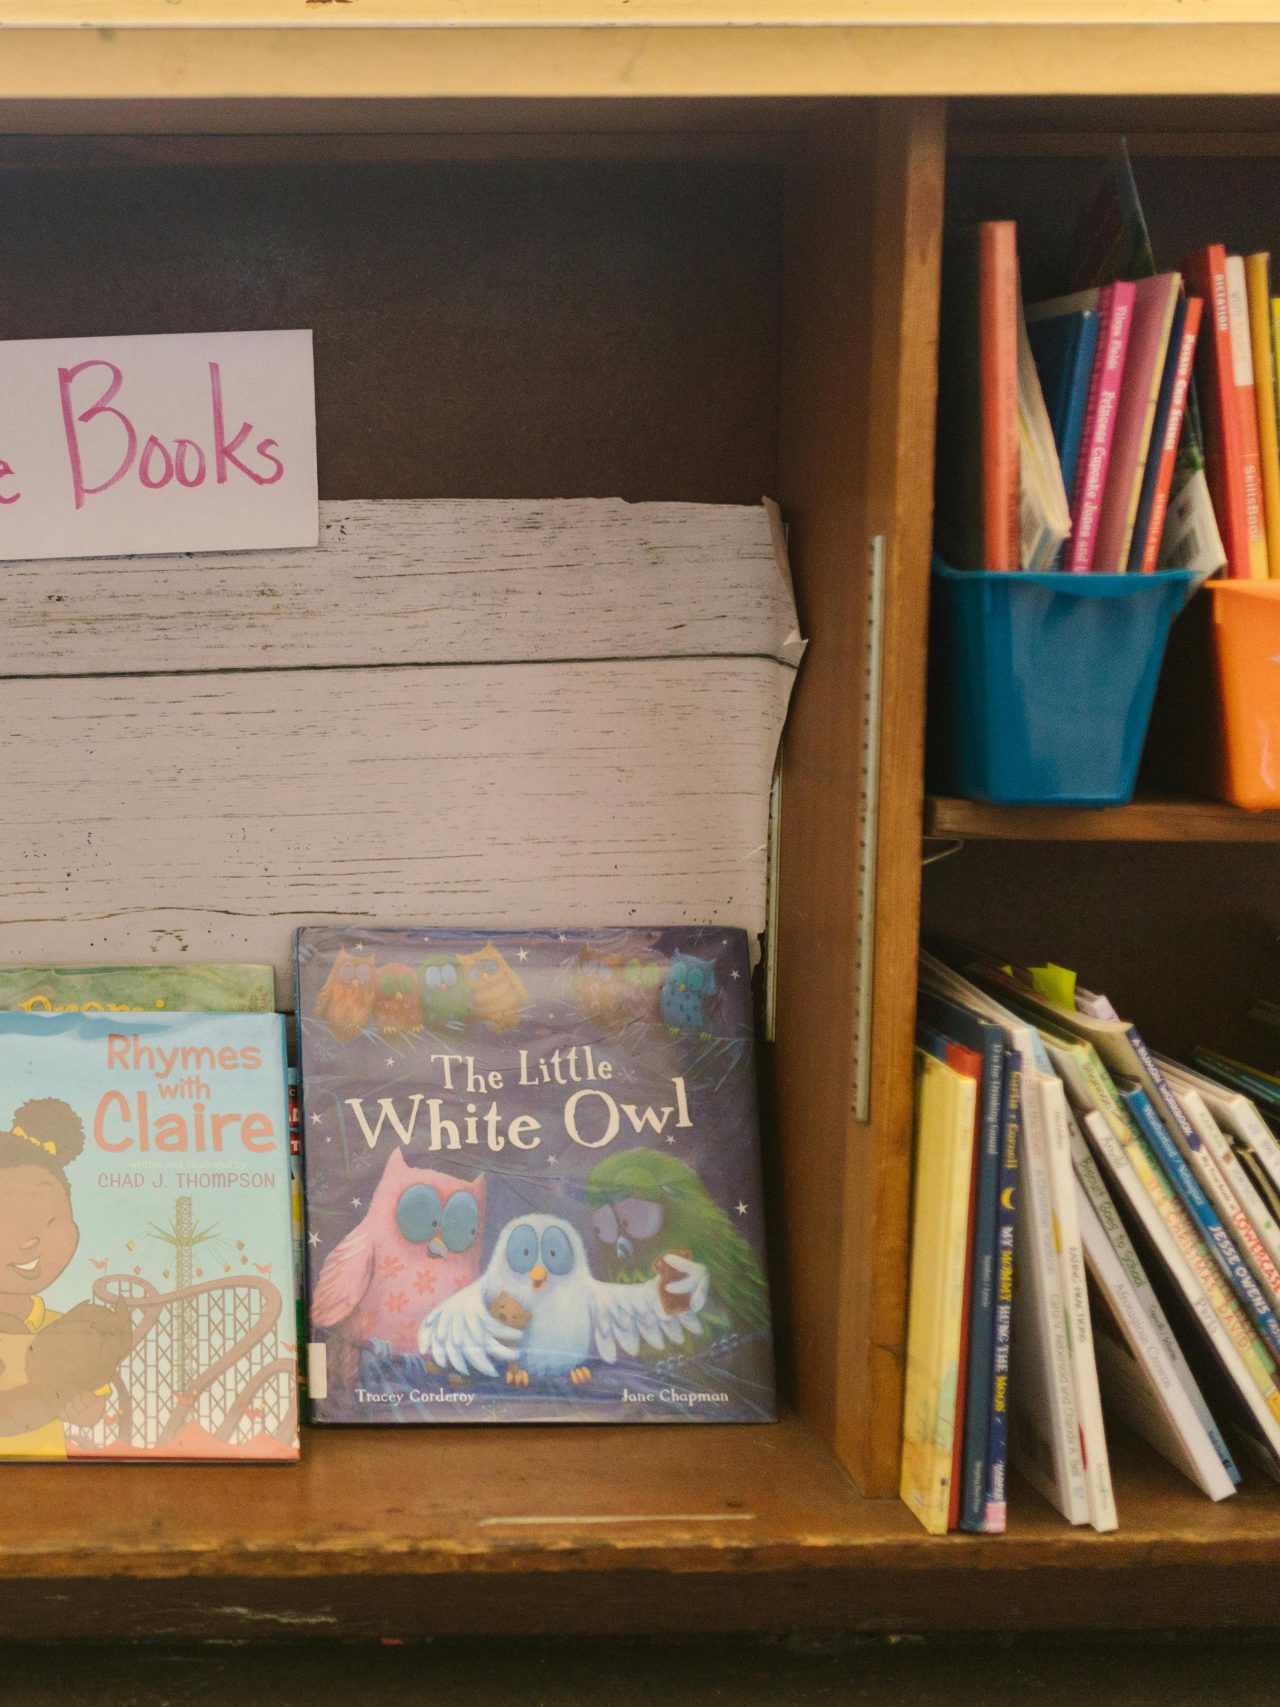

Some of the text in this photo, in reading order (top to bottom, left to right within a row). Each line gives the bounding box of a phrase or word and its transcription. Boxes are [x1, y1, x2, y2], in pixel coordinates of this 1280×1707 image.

[58, 360, 285, 510] Books
[1094, 390, 1116, 443] Princess
[1082, 445, 1106, 500] Cupcake
[1078, 500, 1097, 538] Jones
[107, 1034, 262, 1073] Rhymes
[431, 1045, 613, 1093] The Little
[157, 1076, 211, 1099] with
[1158, 1084, 1193, 1137] WORKBOOK
[93, 1090, 278, 1154] Claire
[344, 1094, 541, 1152] White
[564, 1077, 693, 1149] Owl
[98, 1172, 275, 1188] CHAD J. THOMPSON
[1077, 1156, 1147, 1288] Biscuit Goes to School
[1207, 1221, 1241, 1266] JESSE
[1232, 1263, 1271, 1315] OWENS
[993, 1226, 1013, 1411] MY MOMMY HUNG THE MOON
[1049, 1294, 1062, 1319] Carol
[1061, 1386, 1072, 1404] and
[355, 1388, 475, 1405] Tracey Corderoy
[621, 1388, 729, 1405] Jane Chapman
